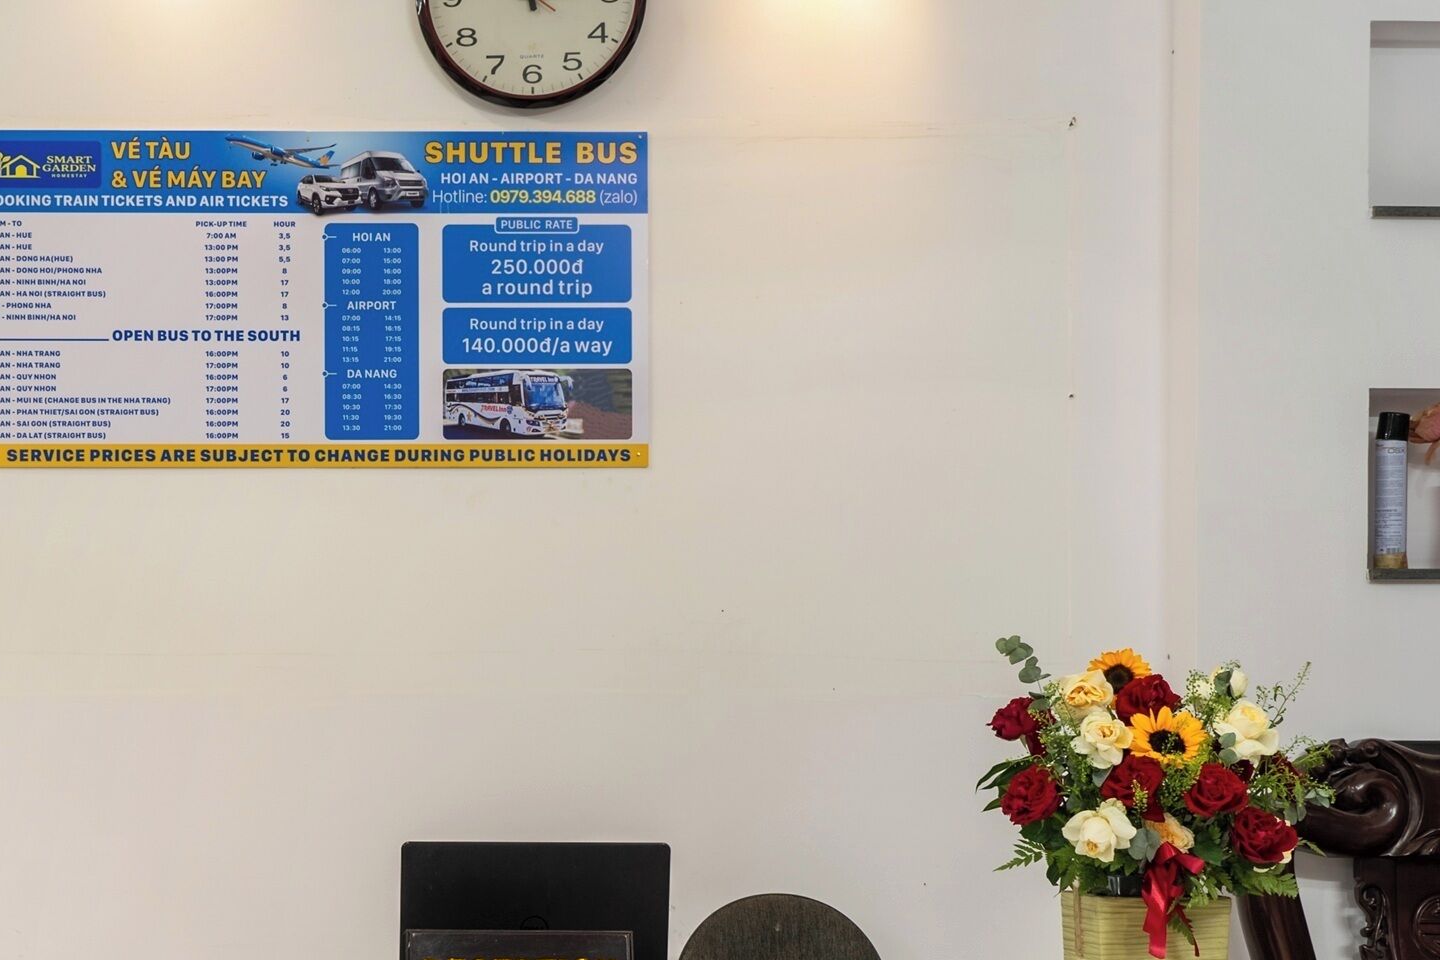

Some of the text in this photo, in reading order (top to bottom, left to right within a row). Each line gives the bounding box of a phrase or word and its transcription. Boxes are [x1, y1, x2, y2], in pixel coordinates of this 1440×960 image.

[455, 27, 478, 47] 8
[587, 21, 609, 44] 4
[485, 54, 506, 76] 7
[562, 51, 583, 71] 5
[521, 64, 544, 84] 6
[111, 136, 191, 160] VÉ TÀU
[424, 140, 639, 165] SHUTTLE BUS
[46, 155, 93, 165] SMART
[41, 162, 97, 174] GARDEN
[111, 164, 267, 189] & VÉ MÁY BAY
[440, 172, 638, 185] HOI AN AIRPORT DA NANG
[53, 194, 99, 207] TRAIN
[101, 194, 163, 207] TICKETS
[165, 195, 197, 207] AND
[199, 195, 225, 207] AIR
[226, 195, 289, 207] TICKETS
[431, 189, 638, 207] Hotline: 0979.394.688 (zalo)
[11, 219, 23, 227] TO
[195, 220, 247, 228] PICK-UP TIME
[273, 220, 296, 228] HOUR
[500, 219, 573, 230] PUBLIC RATE
[0, 231, 11, 239] AN
[15, 231, 33, 239] HUE
[206, 232, 224, 240] 7:00
[278, 232, 291, 241] 3,5
[352, 232, 391, 242] HOI AN
[469, 239, 605, 255] Round trip in a day
[39, 255, 74, 263] HA(HUE)
[204, 255, 239, 263] 13:00 PM
[278, 255, 291, 264] 5,5
[39, 267, 85, 275] HOI/PHONG
[205, 267, 238, 275] 13:00PM
[281, 267, 288, 275] 8
[491, 258, 584, 275] 250.000đ
[0, 278, 11, 286] AN
[16, 278, 37, 286] NINH
[37, 278, 71, 287] BINH/HA
[72, 278, 87, 286] NOI
[280, 290, 289, 298] 17
[481, 279, 593, 299] a round trip
[43, 290, 86, 298] (STRAIGHT
[86, 290, 106, 299] BUS)
[205, 302, 238, 310] 17:00PM
[281, 302, 288, 310] 8
[347, 300, 397, 311] AIRPORT
[5, 313, 26, 321] NINH
[27, 313, 61, 322] BINH/HA
[61, 313, 77, 321] NOI
[280, 314, 290, 322] 13
[469, 317, 605, 333] Round trip in a day
[112, 328, 301, 342] OPEN BUS TO THE SOUTH
[462, 336, 613, 357] 140.000đ/a way
[280, 350, 290, 358] 10
[347, 369, 398, 379] DA NANG
[6, 449, 631, 462] SERVICE PRICES ARE SUBJECT TO CHANGE DURING PUBLIC HOLIDAYS
